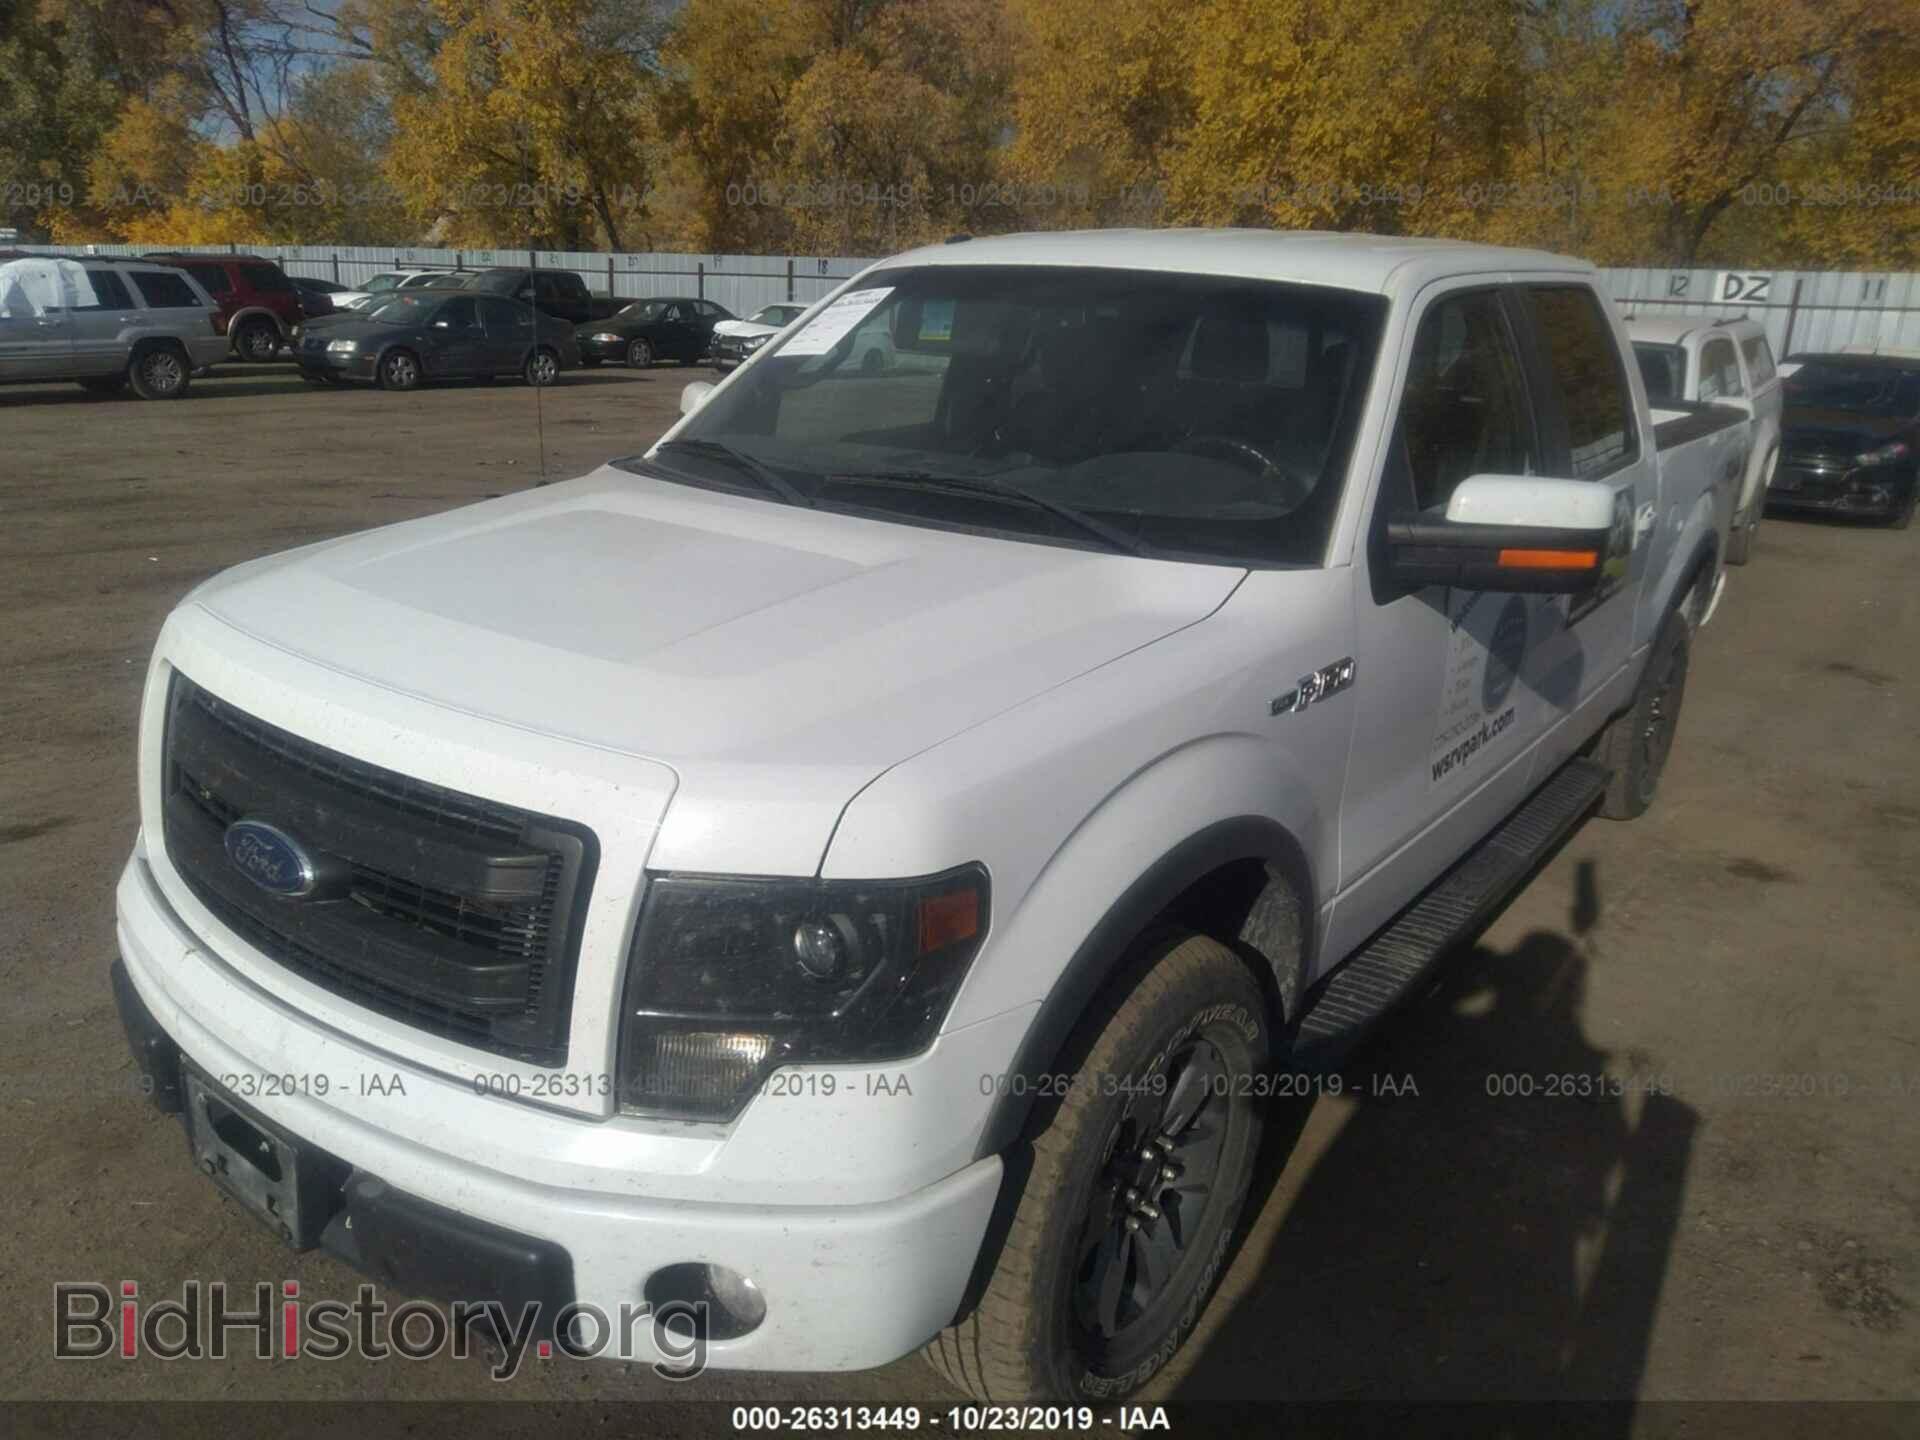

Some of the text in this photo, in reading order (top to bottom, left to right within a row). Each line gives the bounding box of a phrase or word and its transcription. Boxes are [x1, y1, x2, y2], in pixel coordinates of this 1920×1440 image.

[817, 258, 829, 274] 18
[1669, 275, 1690, 297] 12
[1722, 274, 1772, 302] DZ
